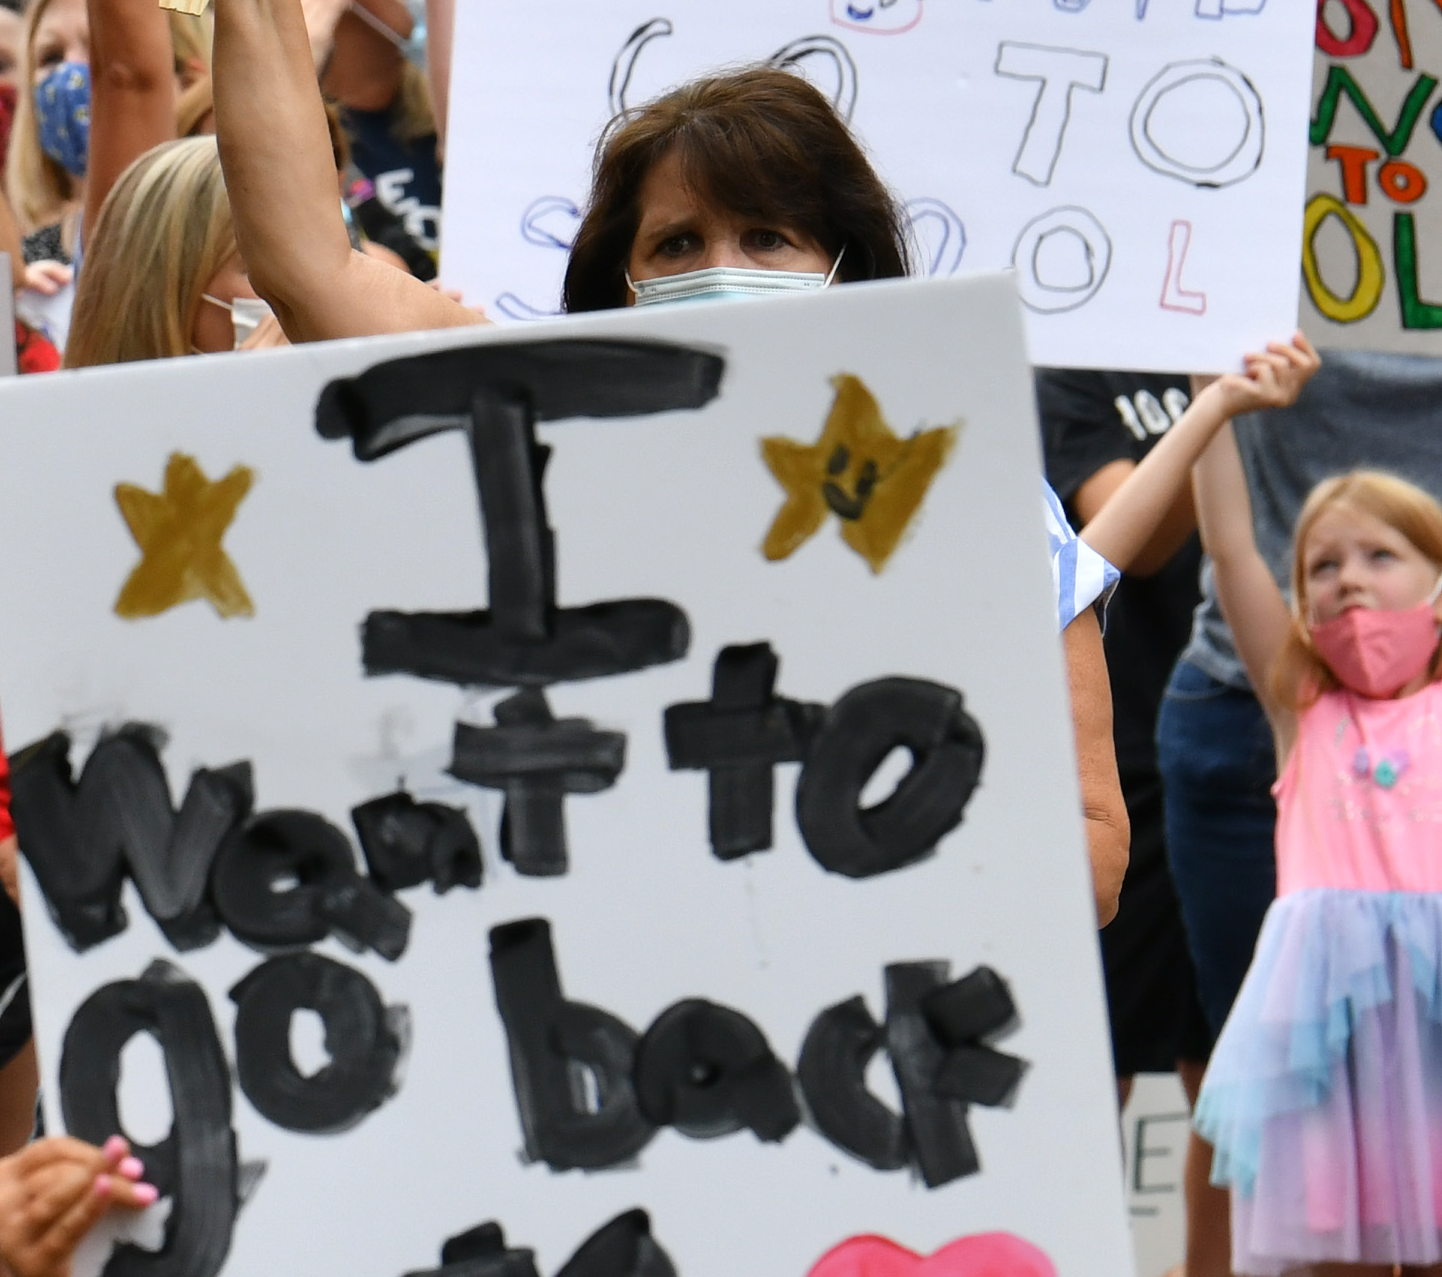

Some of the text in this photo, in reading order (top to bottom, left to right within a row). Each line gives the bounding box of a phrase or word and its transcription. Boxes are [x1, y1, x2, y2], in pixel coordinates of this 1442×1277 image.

[995, 40, 1265, 190] TO
[316, 336, 726, 686] I
[487, 915, 1033, 1191] back
